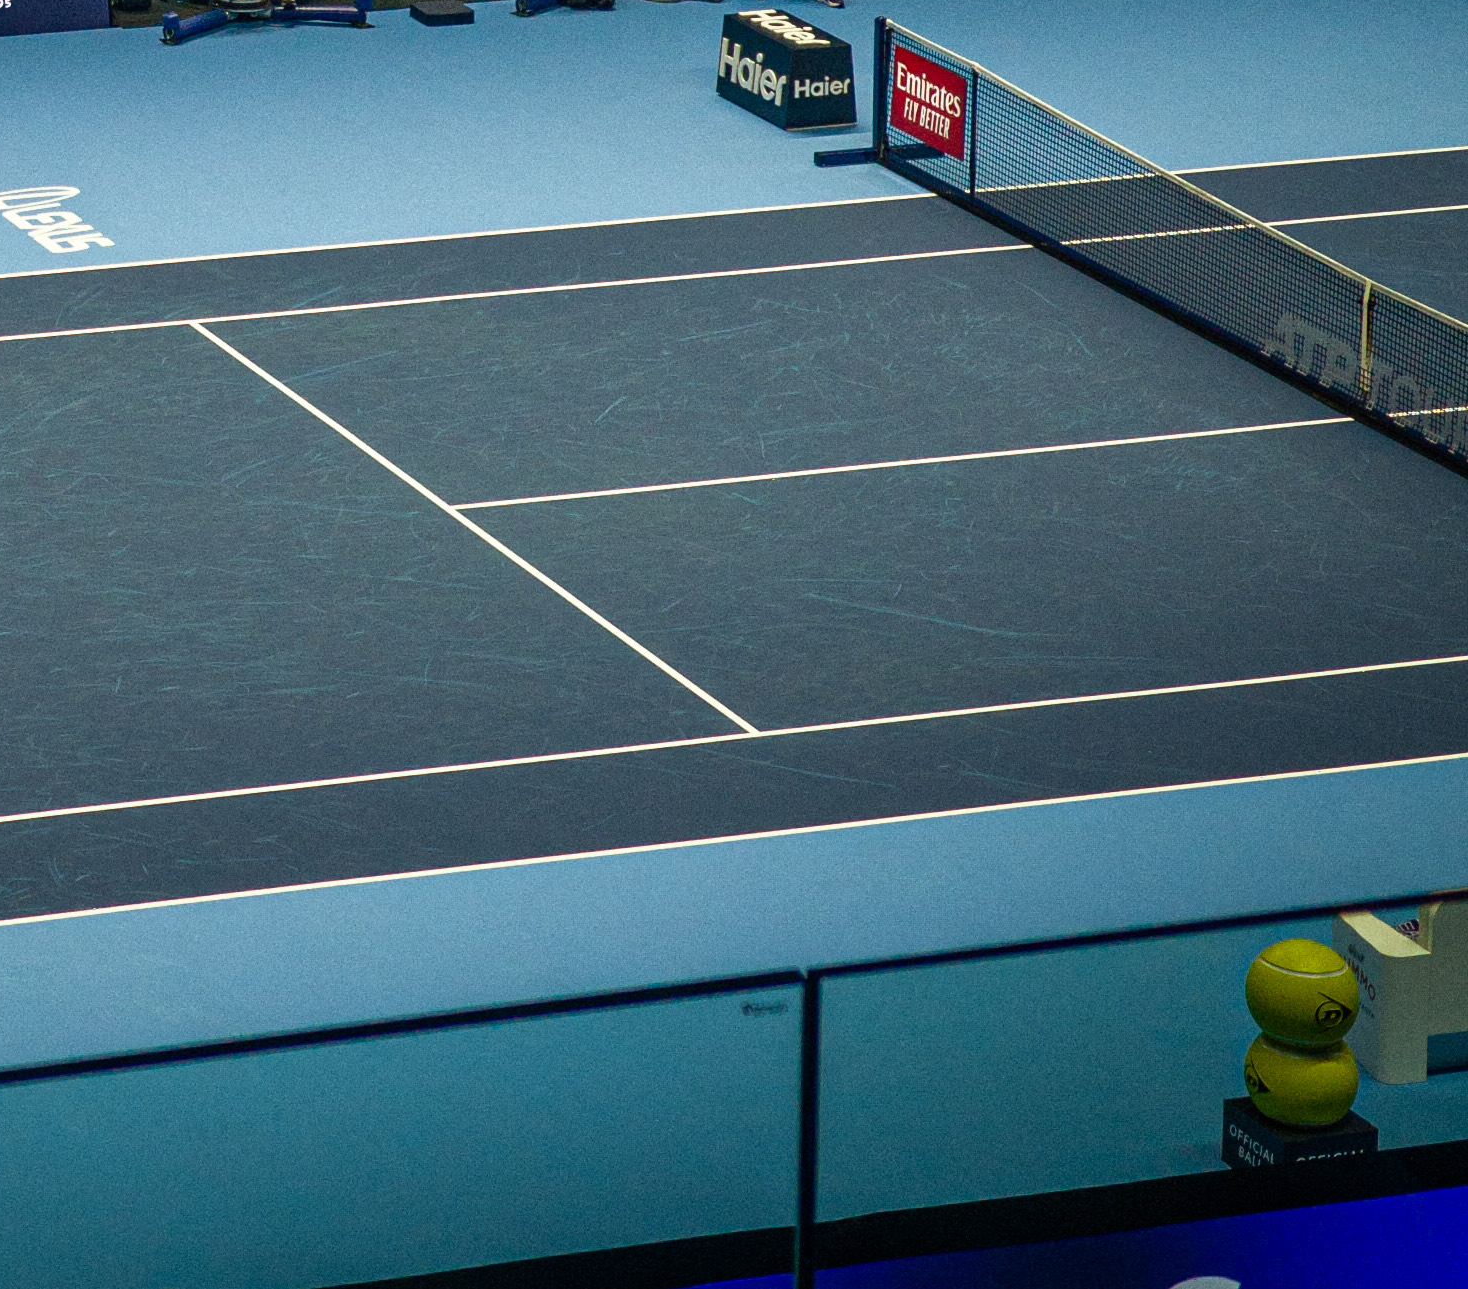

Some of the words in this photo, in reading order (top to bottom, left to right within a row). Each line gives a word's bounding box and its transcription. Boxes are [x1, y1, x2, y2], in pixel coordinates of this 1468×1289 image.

[737, 8, 831, 46] Haier
[719, 37, 788, 107] Haier
[794, 76, 850, 99] Haier
[897, 62, 961, 118] Emirates
[903, 97, 918, 125] FLY
[919, 106, 951, 140] BETTER
[1229, 1123, 1275, 1165] OFFICIAL
